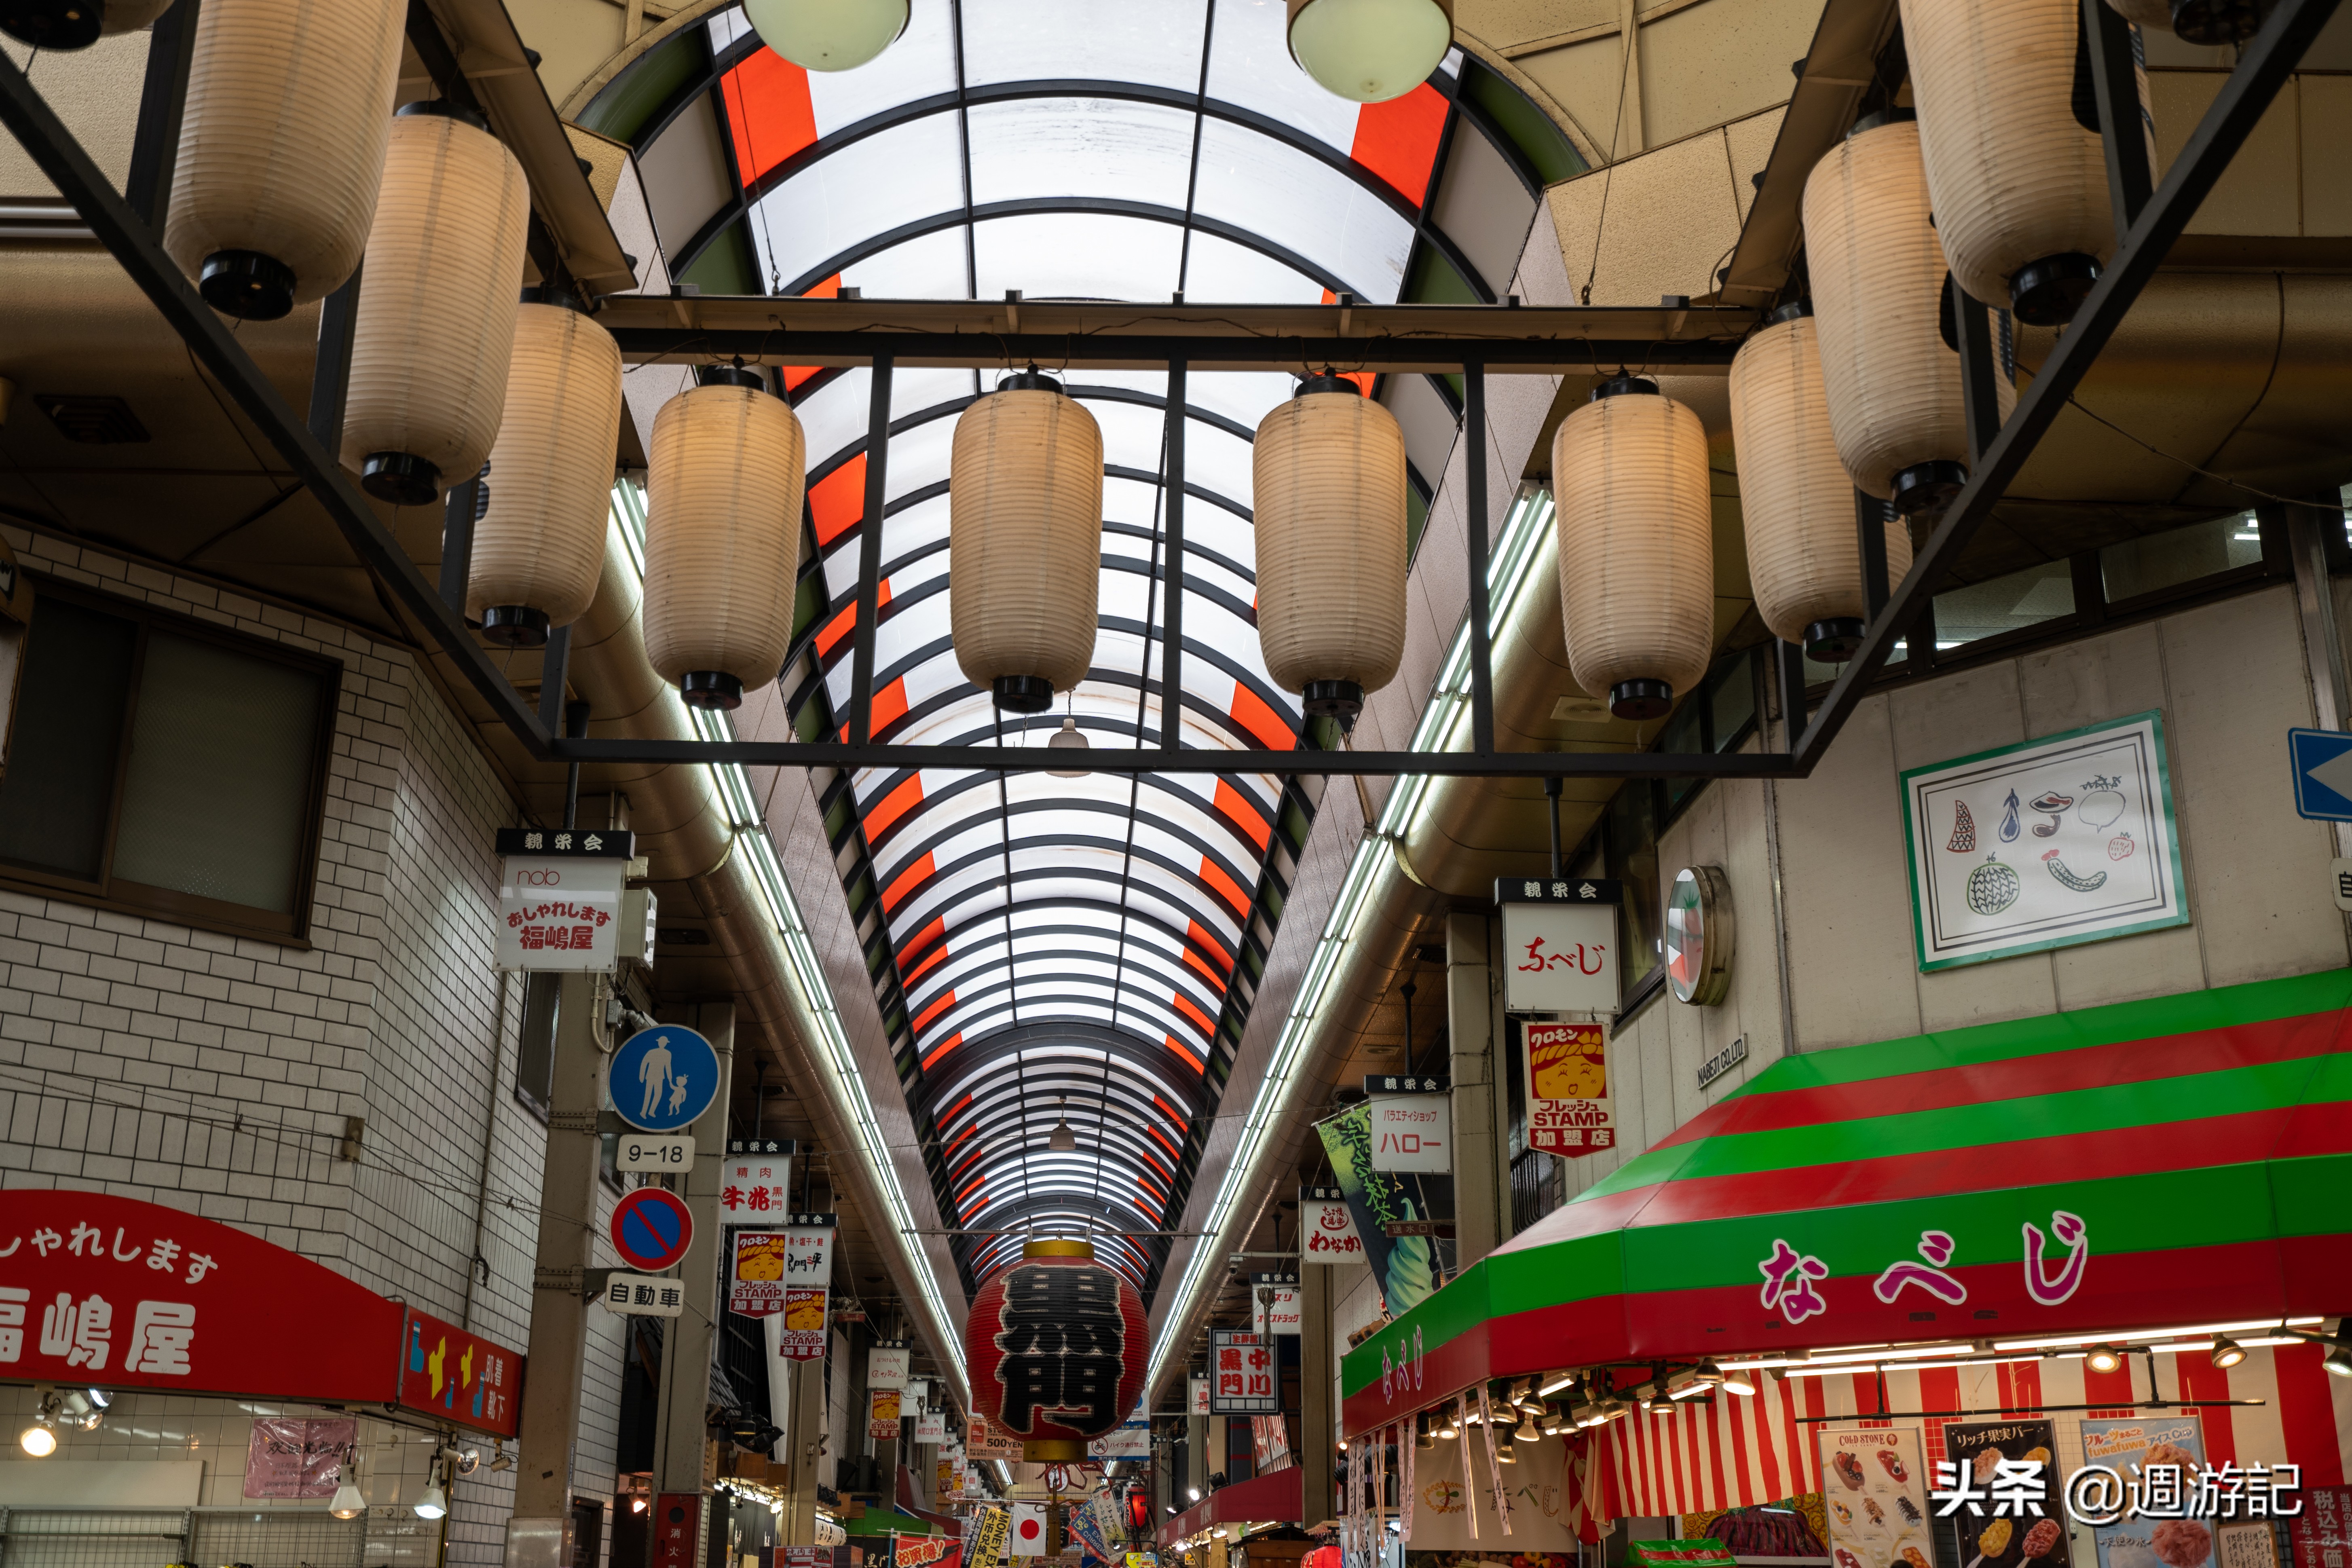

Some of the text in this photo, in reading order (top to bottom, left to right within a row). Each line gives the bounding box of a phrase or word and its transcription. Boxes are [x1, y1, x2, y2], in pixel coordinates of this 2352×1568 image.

[525, 833, 602, 850] 親栄会
[517, 868, 560, 885] nob
[1524, 881, 1597, 899] 親栄会
[506, 902, 611, 928] おしゃれします
[520, 926, 594, 950] 福嶋屋
[1531, 1028, 1578, 1047] クロモン
[1698, 1055, 1719, 1087] NABEJI
[1384, 1078, 1437, 1090] 親栄会
[1539, 1099, 1600, 1112] フレッシュ
[1384, 1109, 1437, 1122] バラエティショップ
[1534, 1112, 1609, 1127] STAMP
[732, 1141, 778, 1152] 親栄会
[1380, 1133, 1441, 1154] ハロー
[1536, 1129, 1610, 1147] 加盟店
[737, 1167, 771, 1178] 精肉
[771, 1187, 783, 1210] 黒門
[1392, 1225, 1427, 1233] 送水口
[740, 1236, 770, 1247] クロモン
[1308, 1230, 1361, 1254] わなか
[1758, 1210, 2088, 1324] なべじ
[739, 1281, 777, 1289] フレッシュ
[1262, 1274, 1294, 1282] 親栄会
[610, 1282, 680, 1308] 自動車
[735, 1289, 782, 1299] STAMP
[787, 1292, 813, 1302] クロモン
[734, 1299, 781, 1311] 加盟店
[783, 1337, 823, 1345] STAMP
[1233, 1334, 1258, 1344] 生鮮館
[783, 1346, 822, 1357] 加盟店
[485, 1354, 503, 1387] 肌着
[1219, 1348, 1243, 1396] 黒門
[1248, 1348, 1271, 1396] 中川
[1382, 1325, 1422, 1405] なべじ
[486, 1391, 505, 1422] 靴下
[1839, 1434, 1885, 1446] COLD STONE
[1957, 1426, 2034, 1447] リッチ果実バー
[2088, 1439, 2146, 1458] fuwafuwa
[976, 1511, 997, 1557] 外币兑换
[990, 1514, 1009, 1553] MONEY
[668, 1528, 681, 1568] 消火
